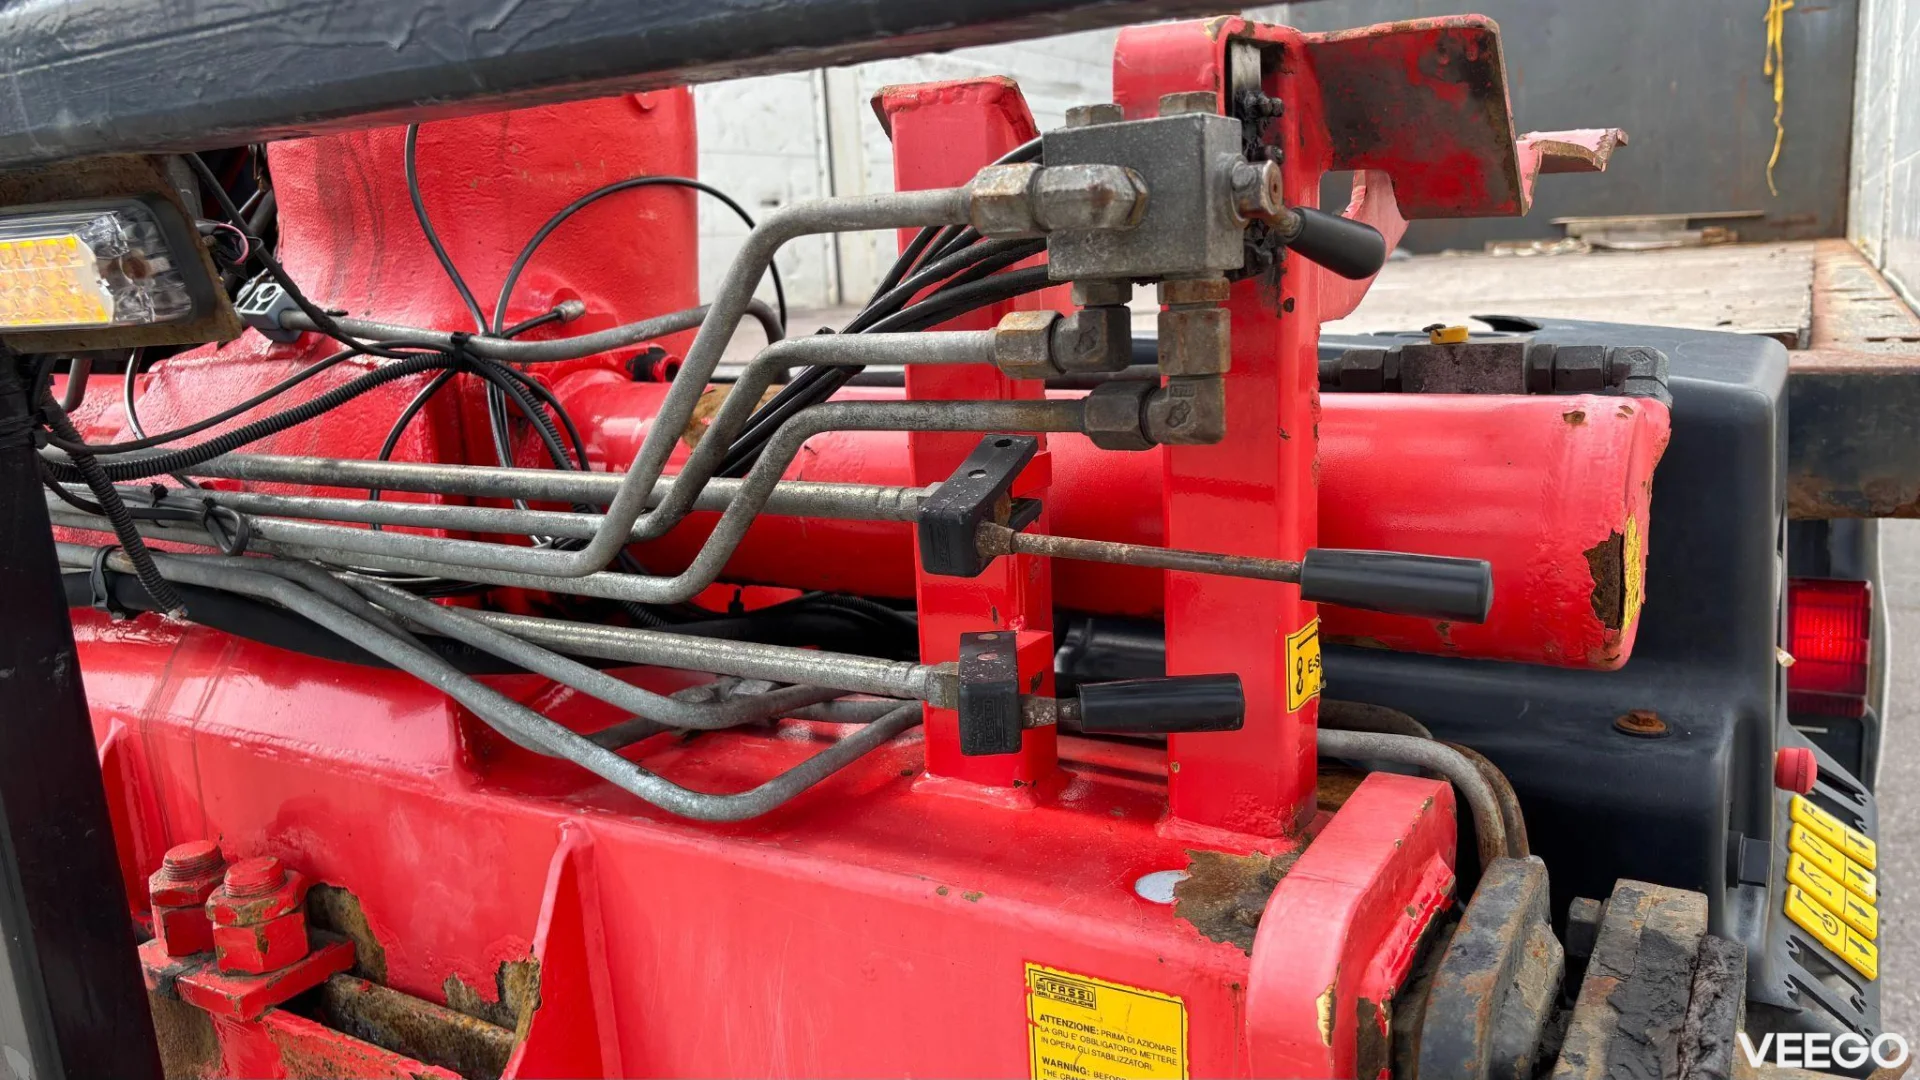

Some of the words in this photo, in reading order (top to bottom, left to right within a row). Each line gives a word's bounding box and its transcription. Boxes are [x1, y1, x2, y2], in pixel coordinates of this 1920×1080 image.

[1050, 984, 1090, 1000] FASSI
[1040, 1014, 1099, 1035] ATTENZIONE:
[1101, 1030, 1125, 1041] PRIMA
[1127, 1035, 1135, 1043] DI
[1136, 1038, 1177, 1055] AZIONARE
[1052, 1028, 1068, 1038] GRU
[1080, 1035, 1137, 1056] OBBLIGATORIO
[1139, 1050, 1177, 1066] METTERE
[1041, 1036, 1049, 1044] IN
[1050, 1038, 1076, 1051] OPERA
[1077, 1045, 1090, 1055] GLI
[1091, 1049, 1154, 1072] STABILIZZATORI.
[1042, 1056, 1090, 1076] WARNING:
[1043, 1068, 1057, 1078] THE
